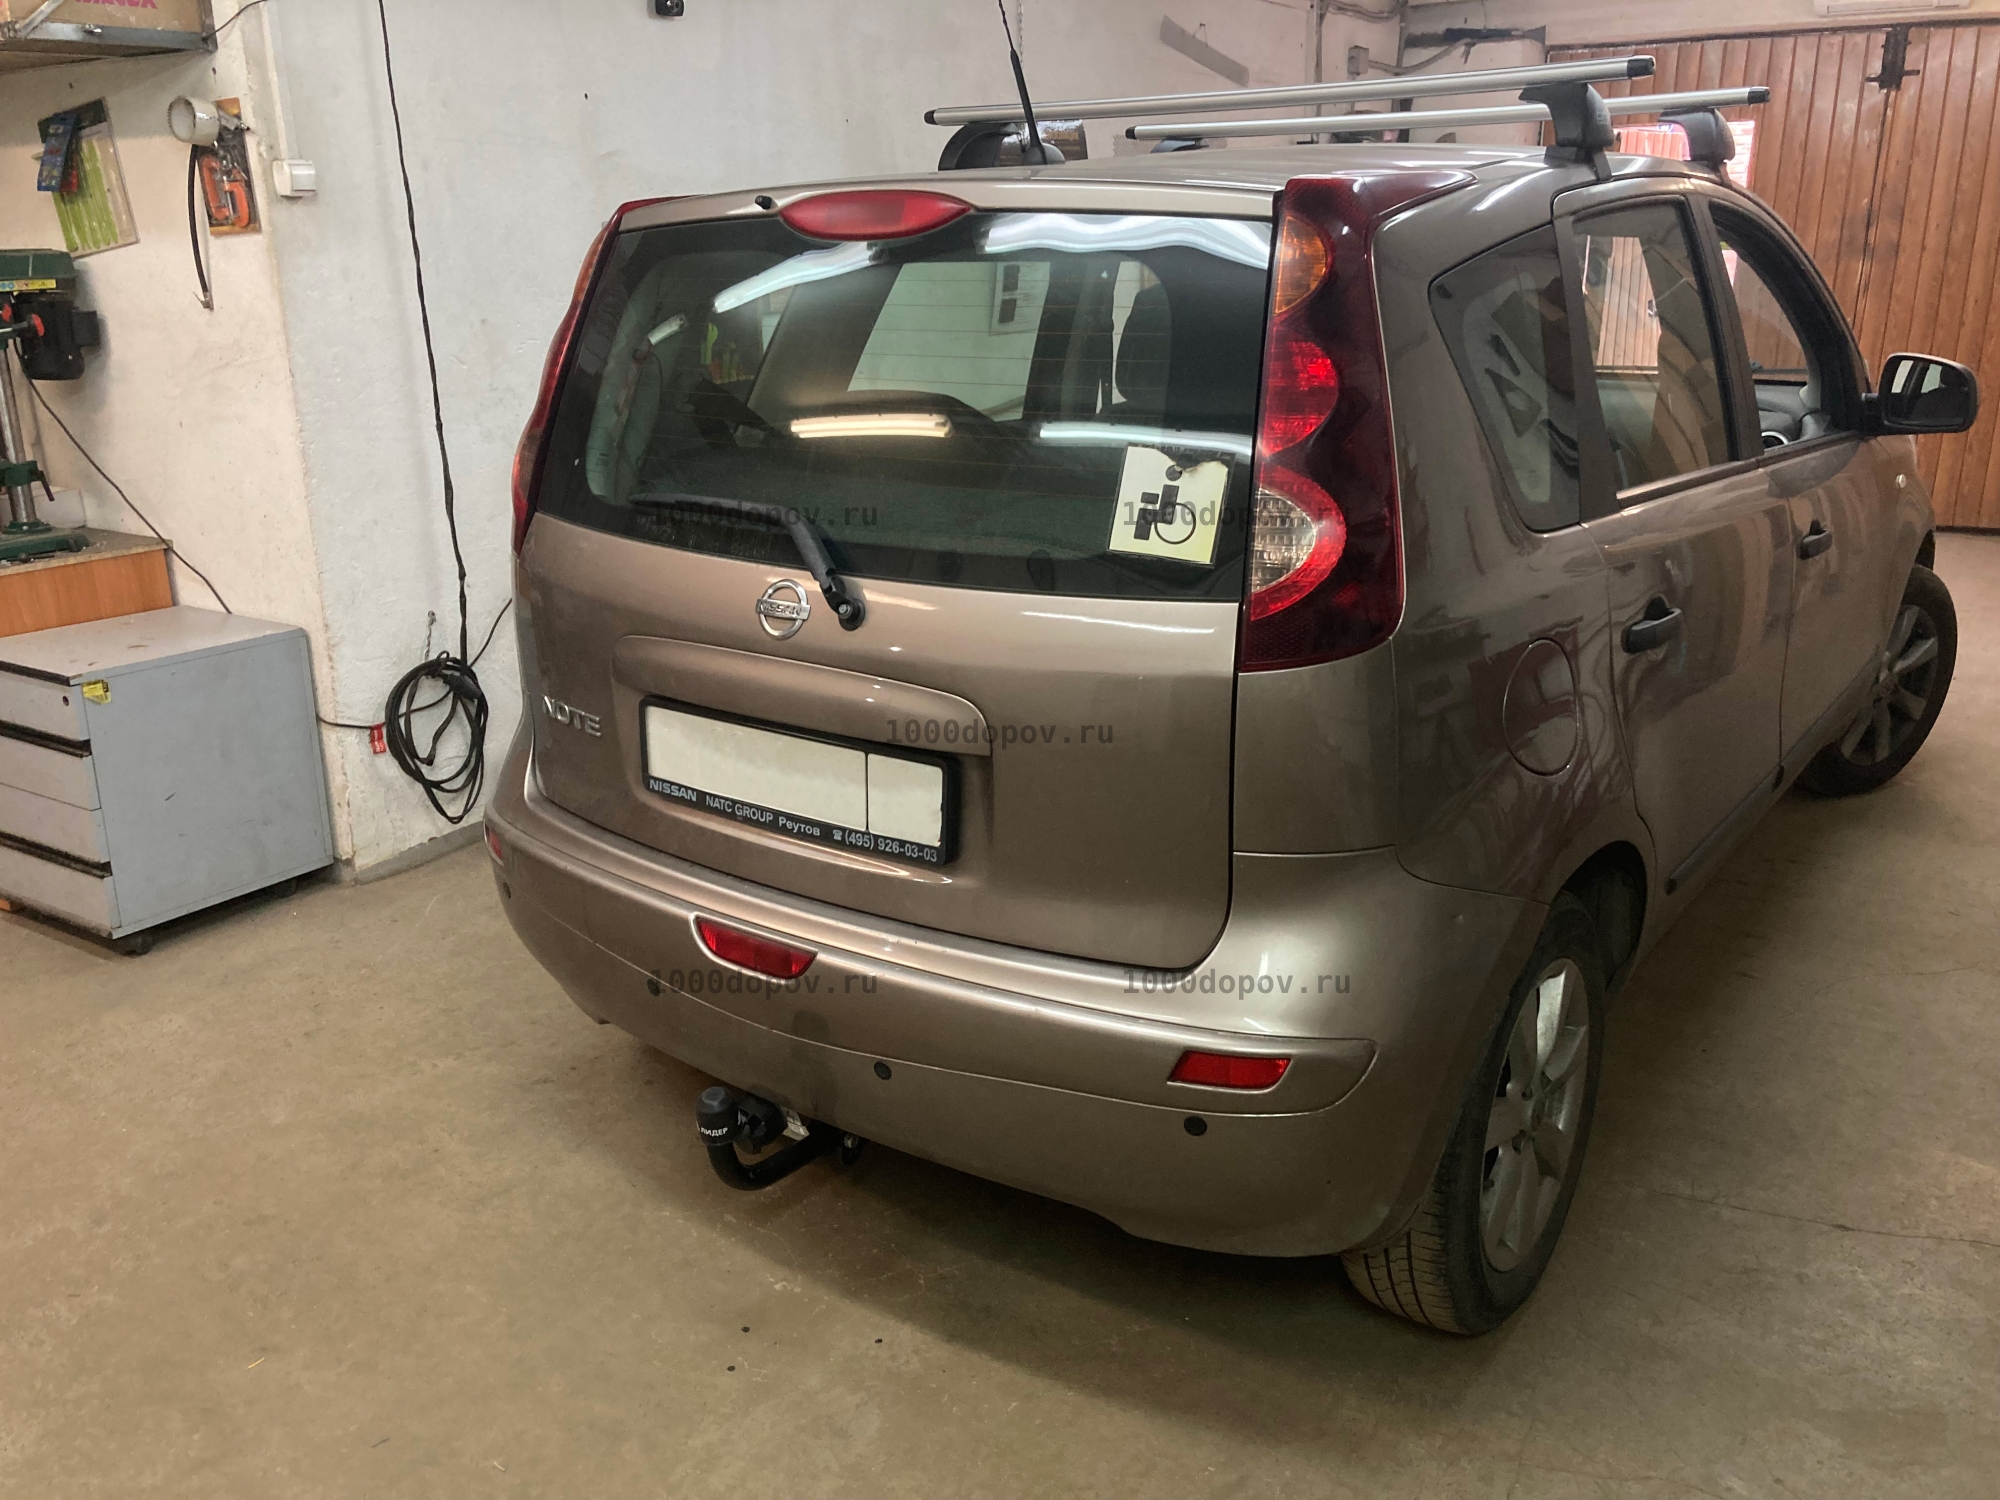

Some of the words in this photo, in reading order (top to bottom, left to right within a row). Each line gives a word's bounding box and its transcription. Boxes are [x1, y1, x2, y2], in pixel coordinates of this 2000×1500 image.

[541, 694, 602, 737] NOTE
[649, 778, 697, 802] NISSAN
[705, 794, 733, 813] NATC
[734, 803, 774, 824] GROUP
[778, 815, 821, 837] Реутов
[845, 829, 875, 850] (495)
[877, 837, 938, 862] 926-03-03
[700, 1126, 729, 1137] ЛИДЕР
